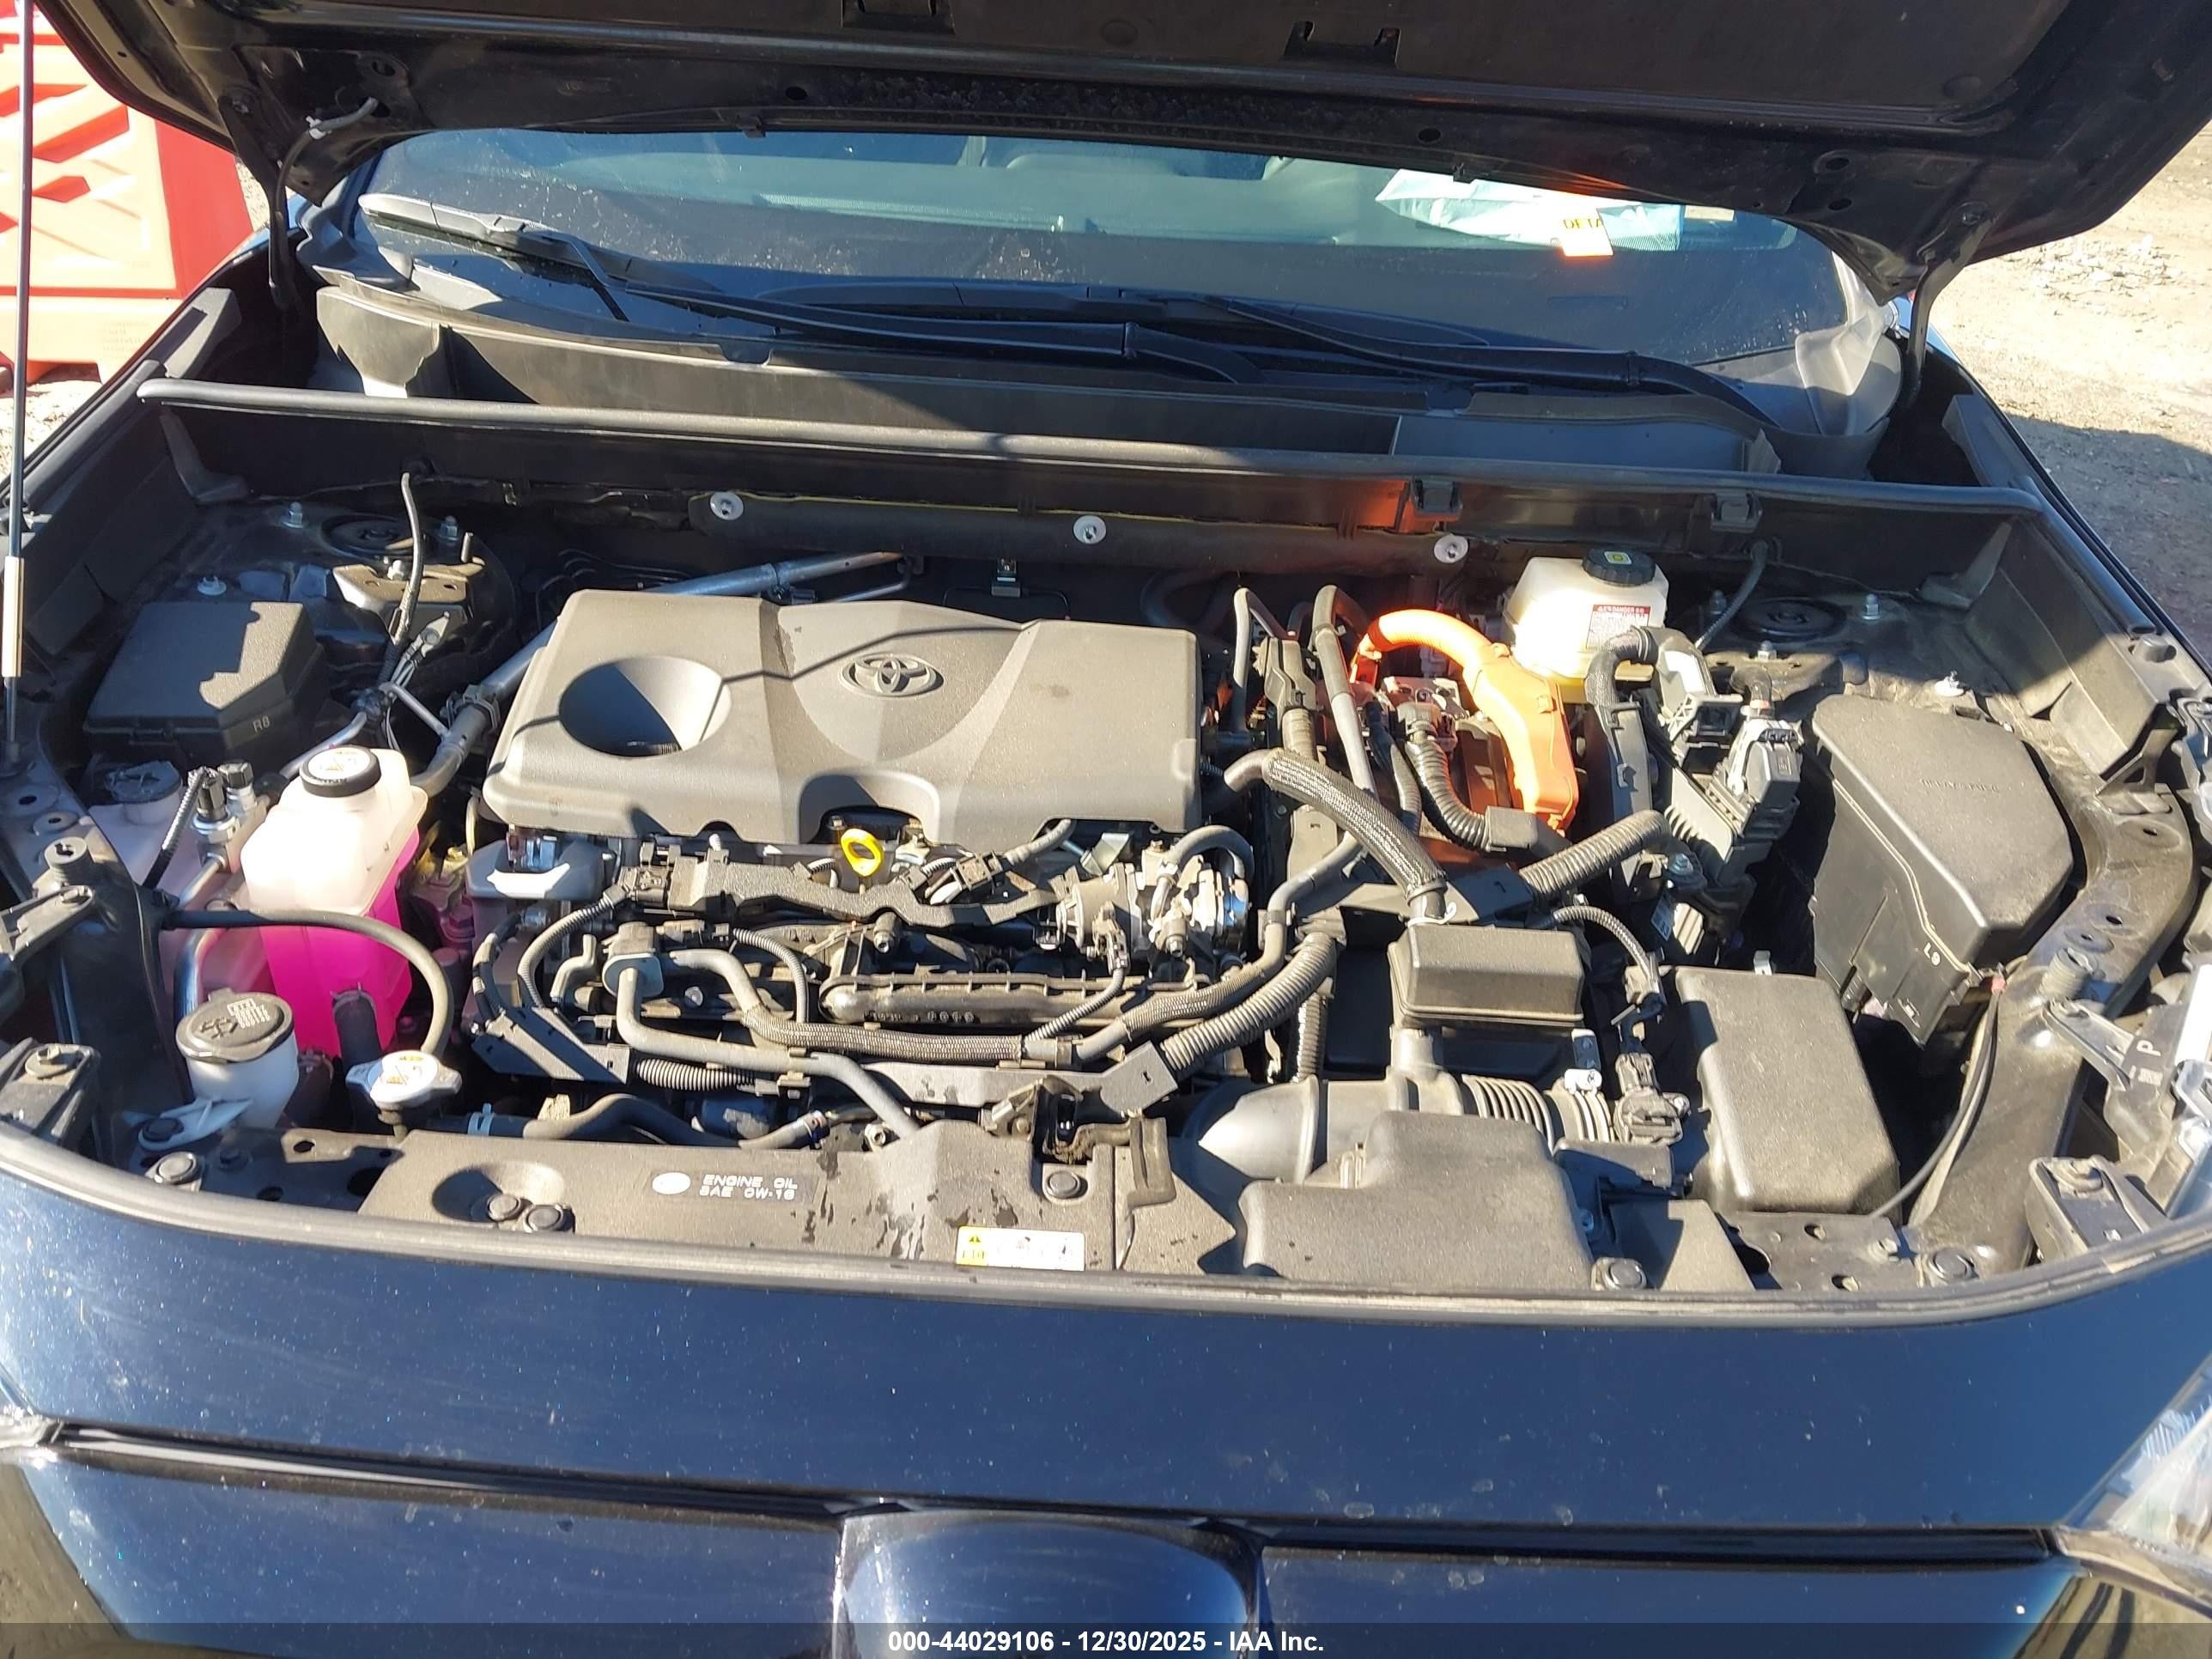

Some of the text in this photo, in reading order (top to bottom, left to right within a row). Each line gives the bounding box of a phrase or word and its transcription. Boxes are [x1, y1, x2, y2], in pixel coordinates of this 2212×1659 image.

[702, 1174, 799, 1190] ENGINE OIL
[699, 1186, 734, 1198] SAE
